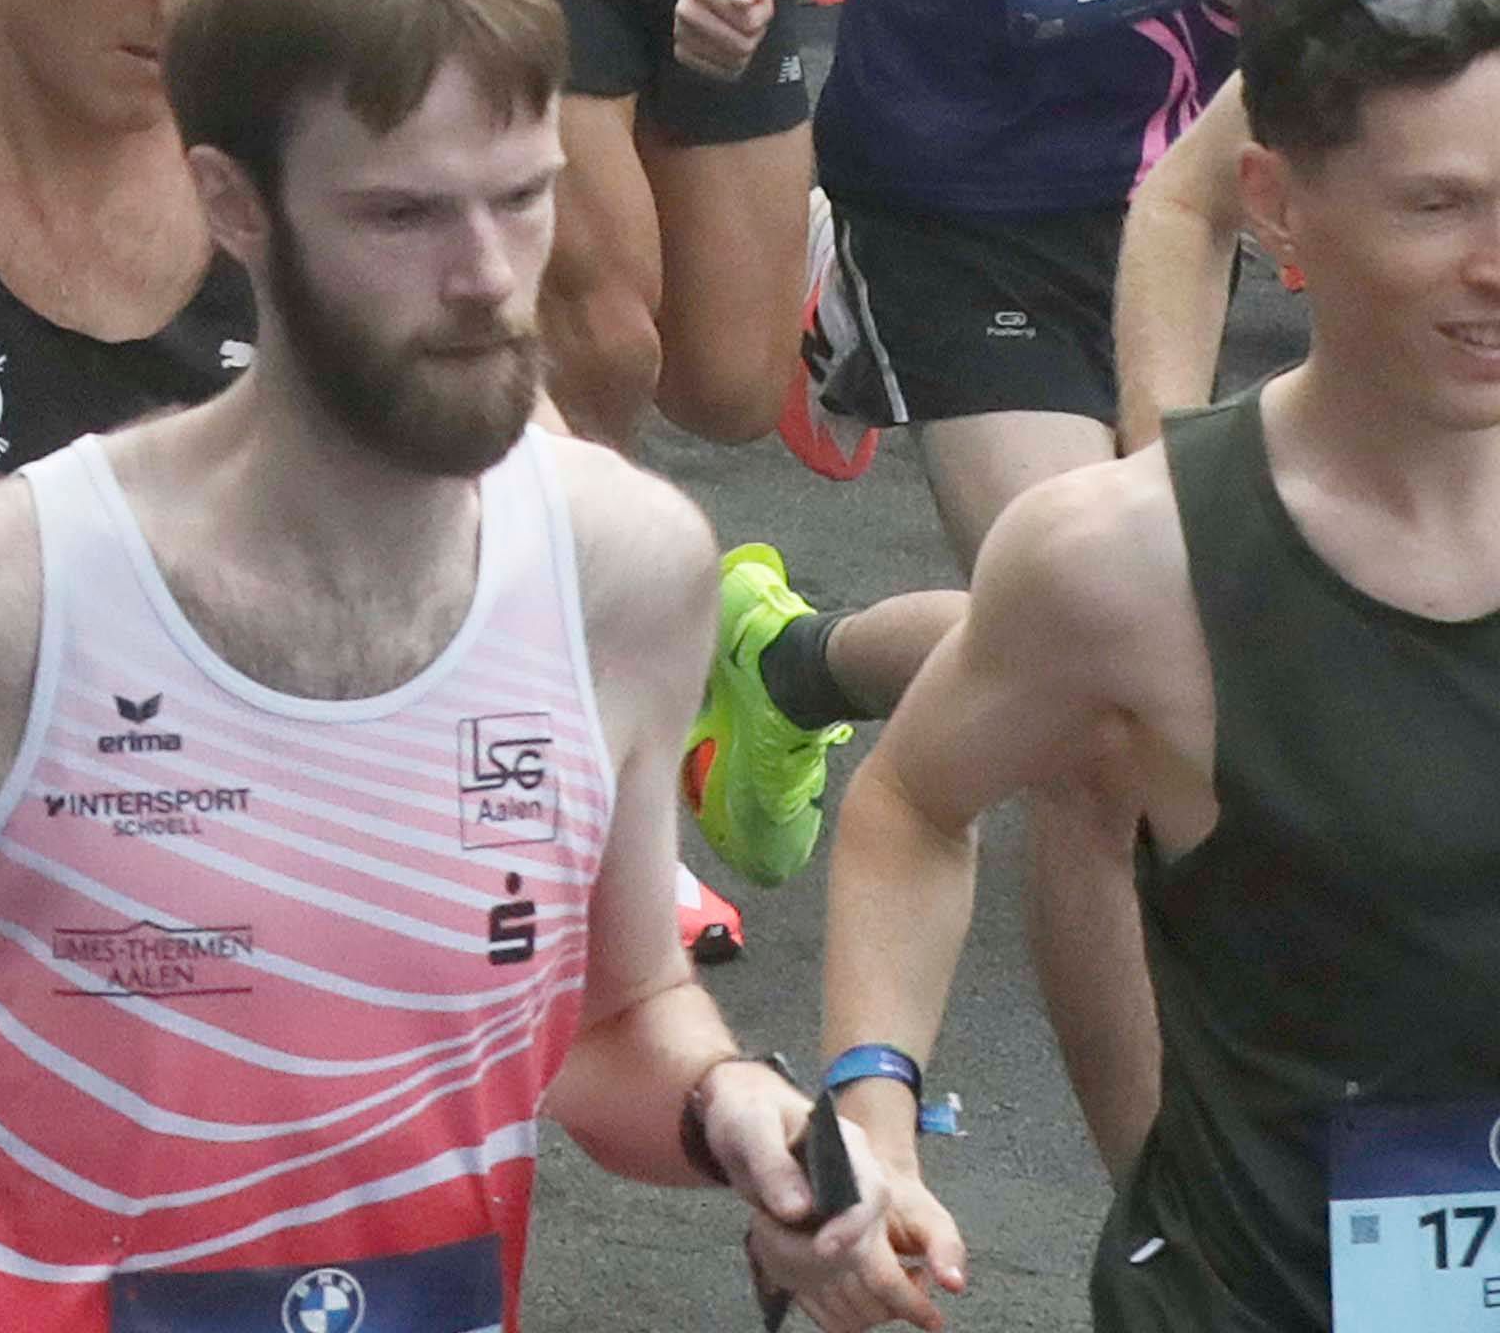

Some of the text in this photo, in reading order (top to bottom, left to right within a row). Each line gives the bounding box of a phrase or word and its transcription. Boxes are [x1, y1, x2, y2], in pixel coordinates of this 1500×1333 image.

[97, 731, 183, 754] erima
[67, 787, 253, 818] INTERSPORT
[475, 795, 544, 825] Aalen
[51, 932, 255, 962] LIMES-THERMEN
[105, 963, 198, 989] AALEN
